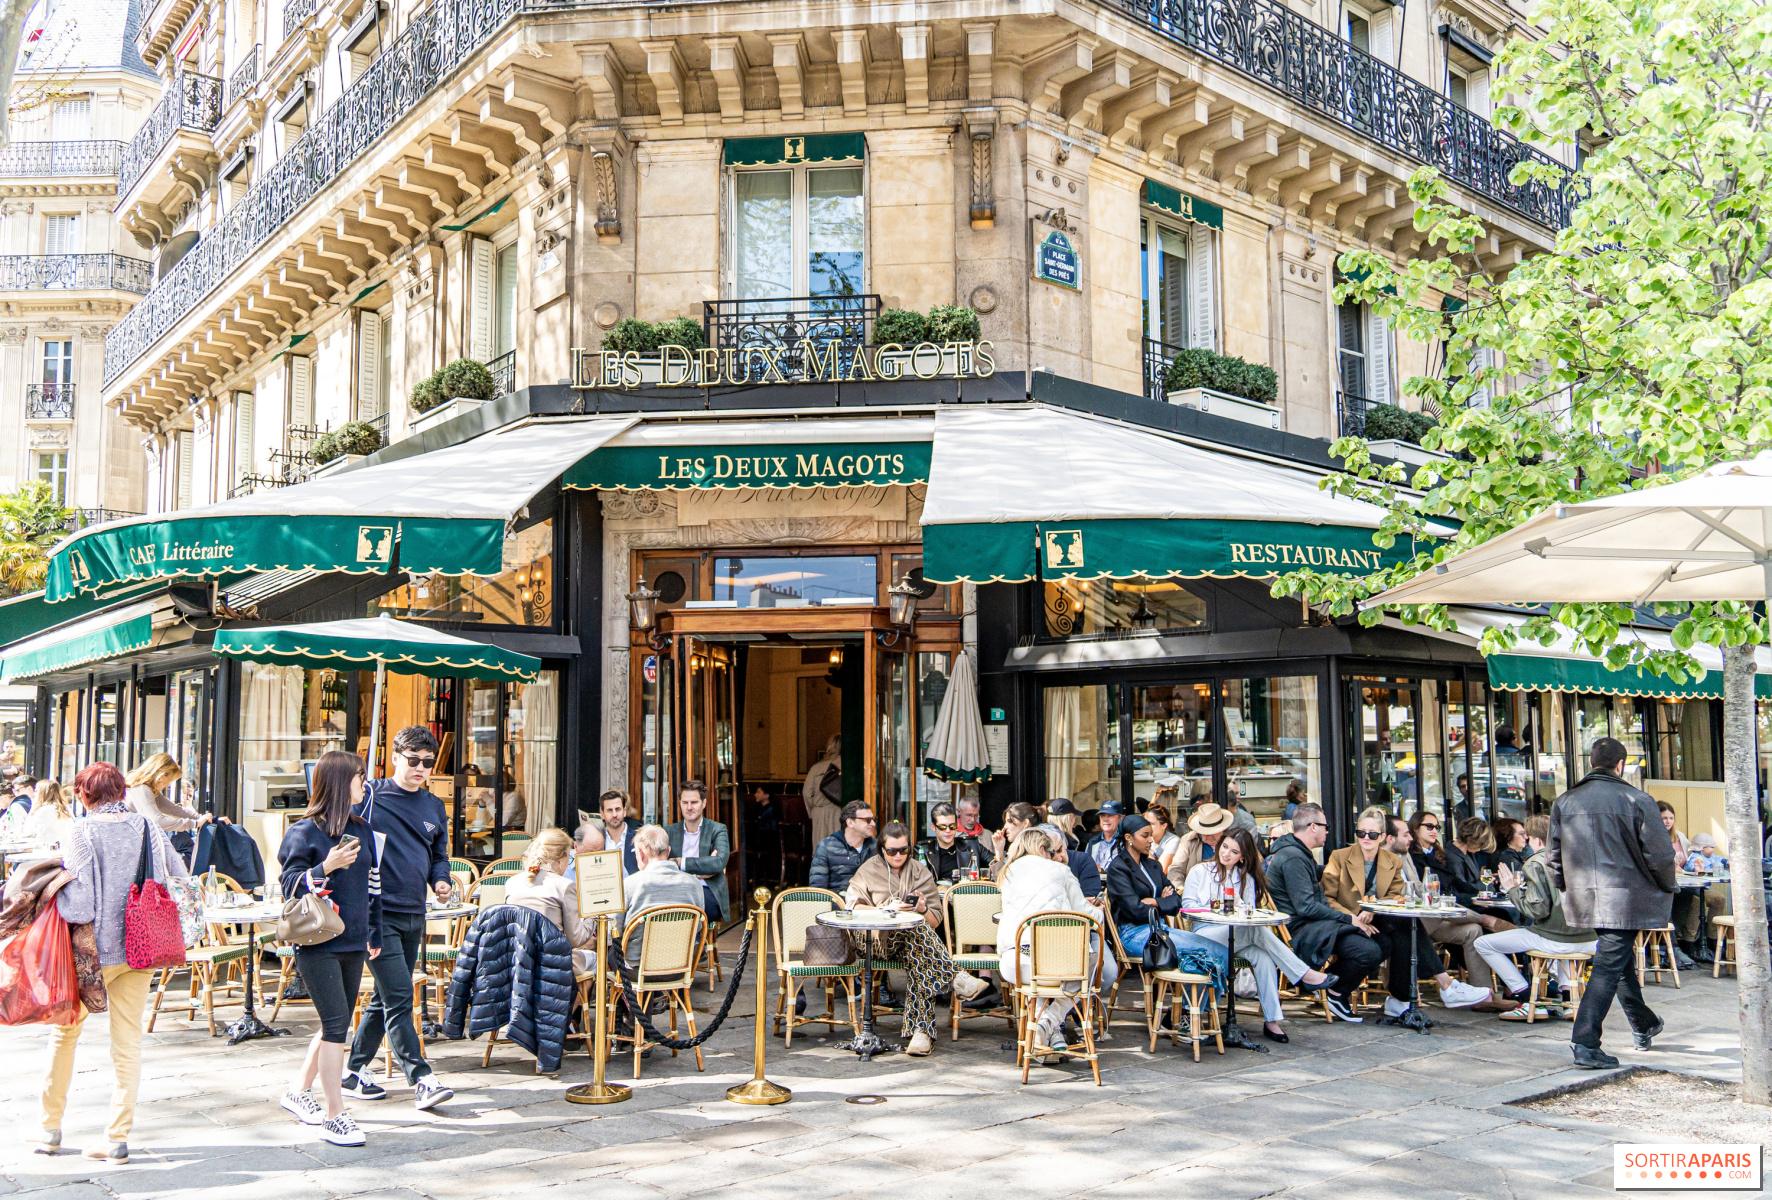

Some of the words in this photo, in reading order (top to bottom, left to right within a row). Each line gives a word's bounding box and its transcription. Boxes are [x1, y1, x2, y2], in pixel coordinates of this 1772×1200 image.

[1052, 251, 1066, 261] PLACE
[570, 347, 644, 389] LES
[656, 344, 789, 388] DEUX
[799, 339, 996, 383] MAGOTS
[658, 456, 706, 479] LES
[713, 454, 788, 478] DEUX
[795, 453, 905, 478] MAGOTS
[162, 540, 234, 561] Littéraire
[1230, 543, 1382, 570] RESTAURANT
